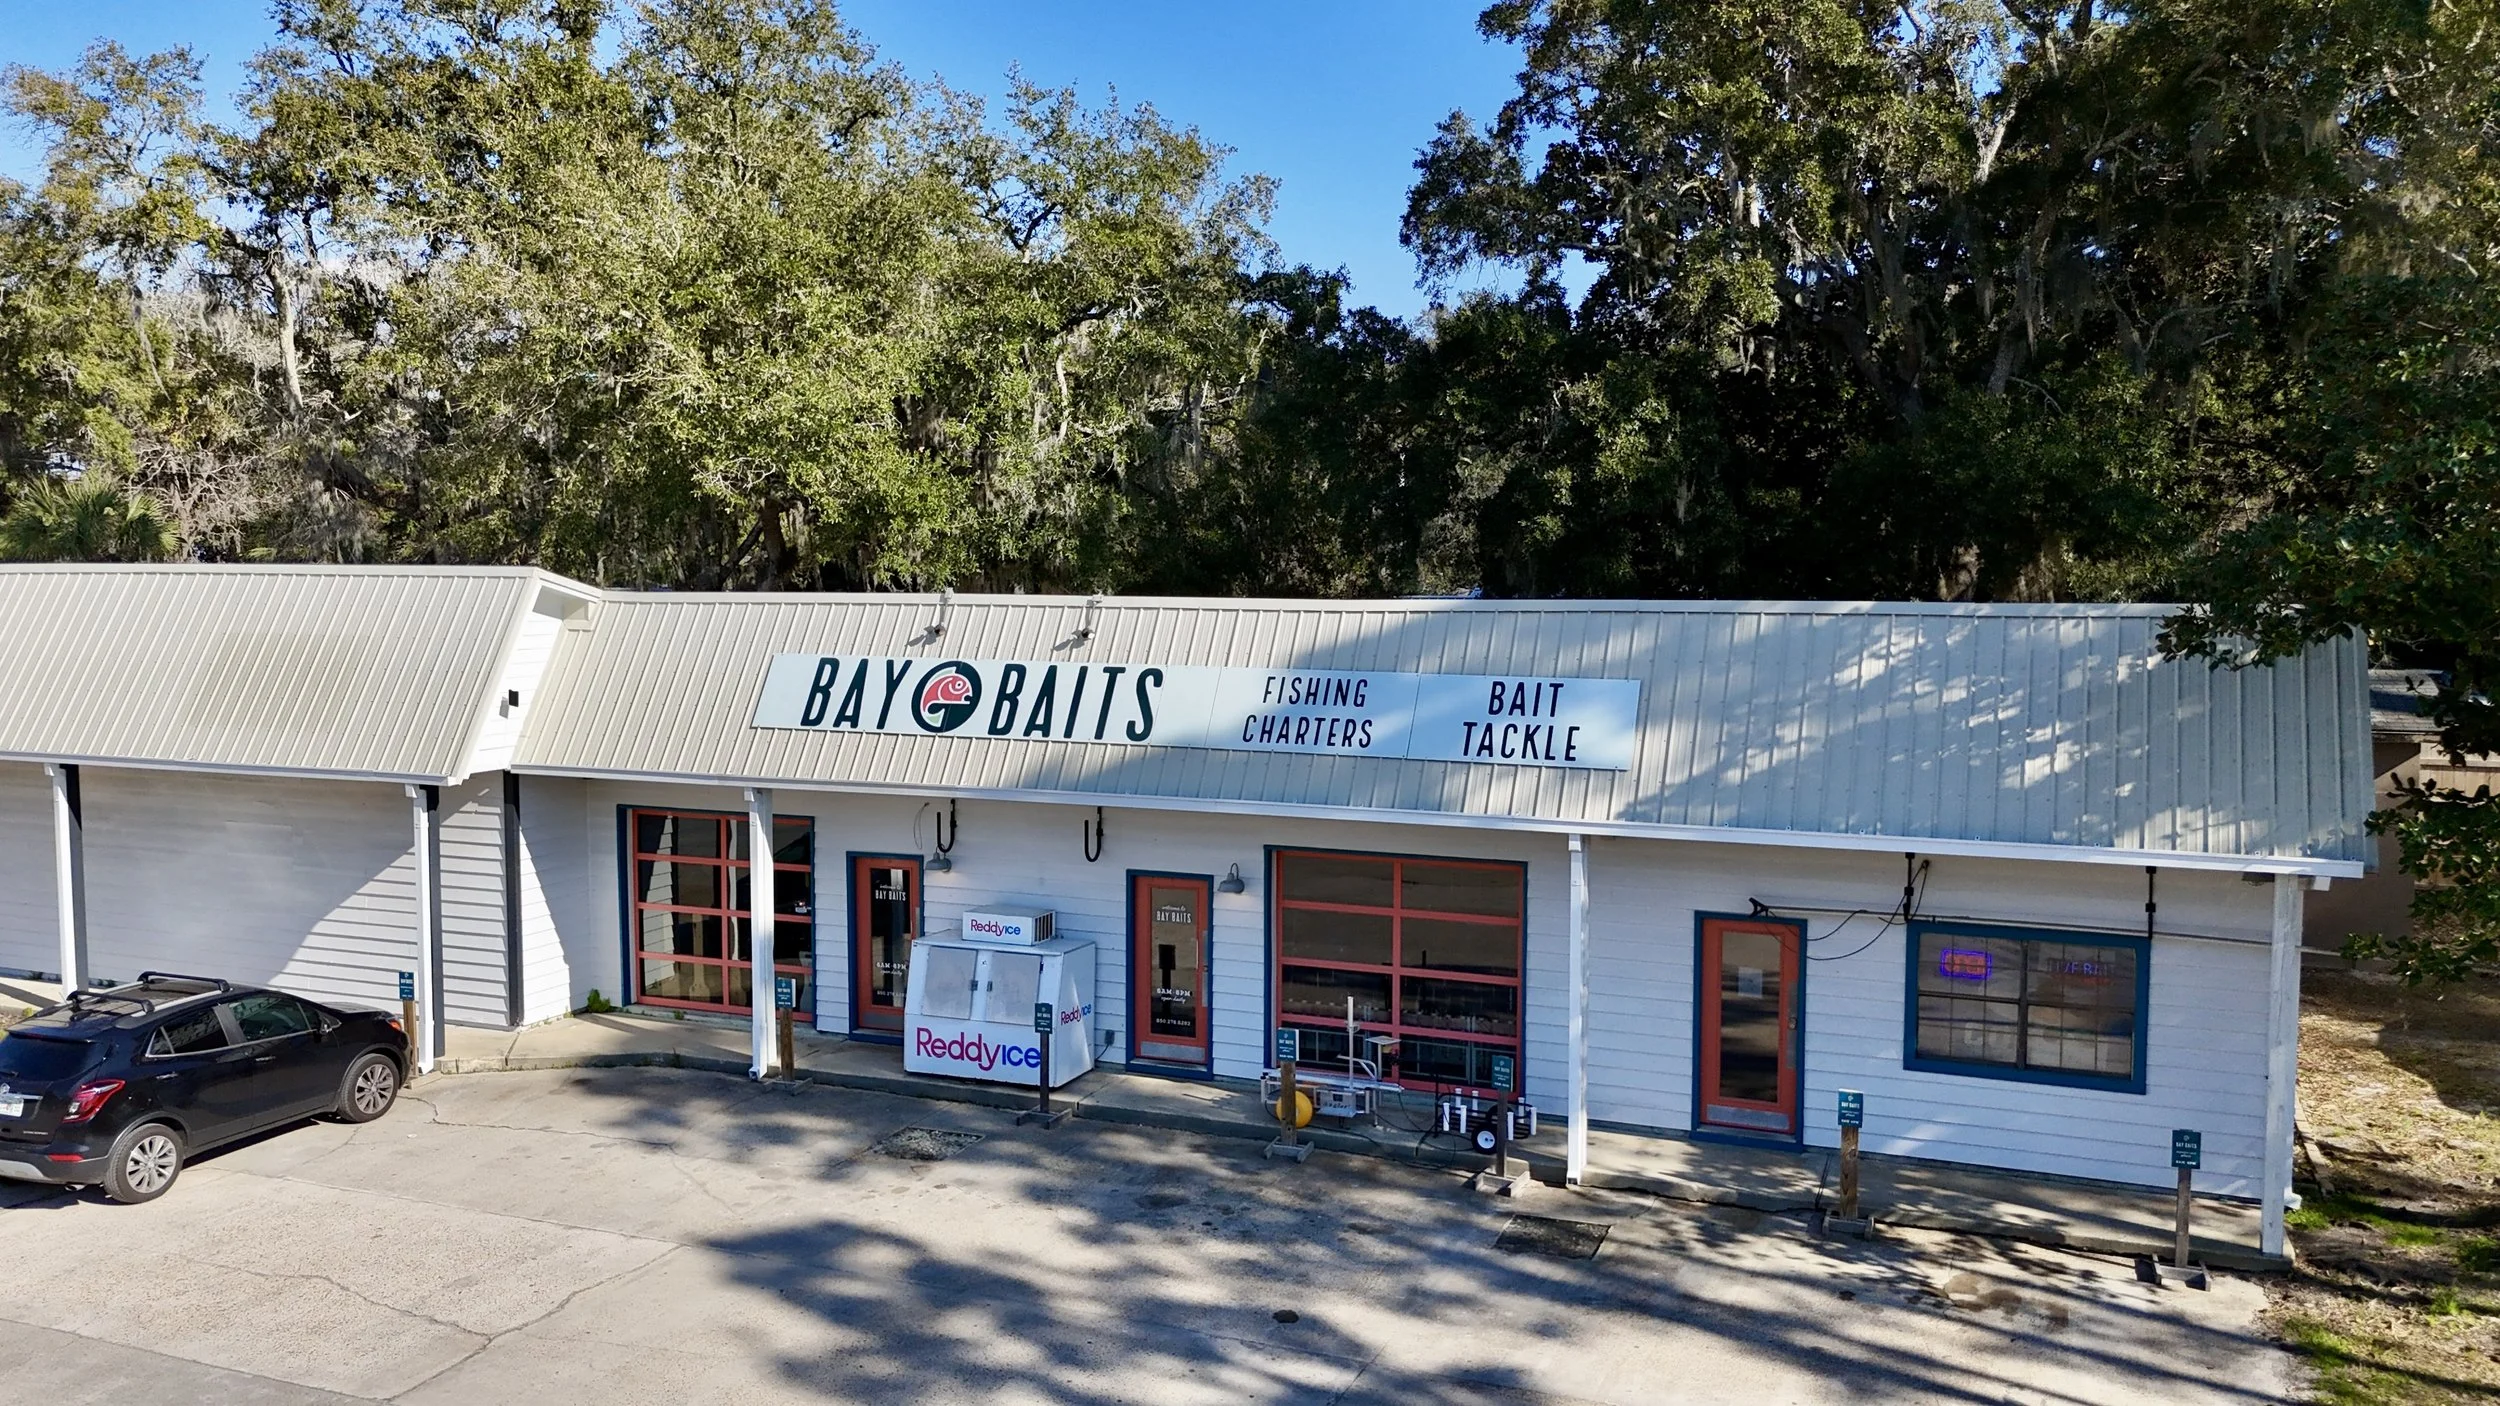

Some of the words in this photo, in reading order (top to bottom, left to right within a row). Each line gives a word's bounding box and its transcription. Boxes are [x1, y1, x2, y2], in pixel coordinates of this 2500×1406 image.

[801, 657, 912, 730] BAY
[987, 663, 1164, 742] BAITS
[1262, 676, 1368, 708] FISHING
[1487, 680, 1565, 718] BAIT
[1242, 714, 1373, 749] CHARTERS
[1462, 721, 1580, 762] TACKLE
[875, 889, 887, 900] BAY
[889, 890, 906, 902] BAITS
[1156, 911, 1170, 921] BAY
[1171, 912, 1192, 924] BAITS
